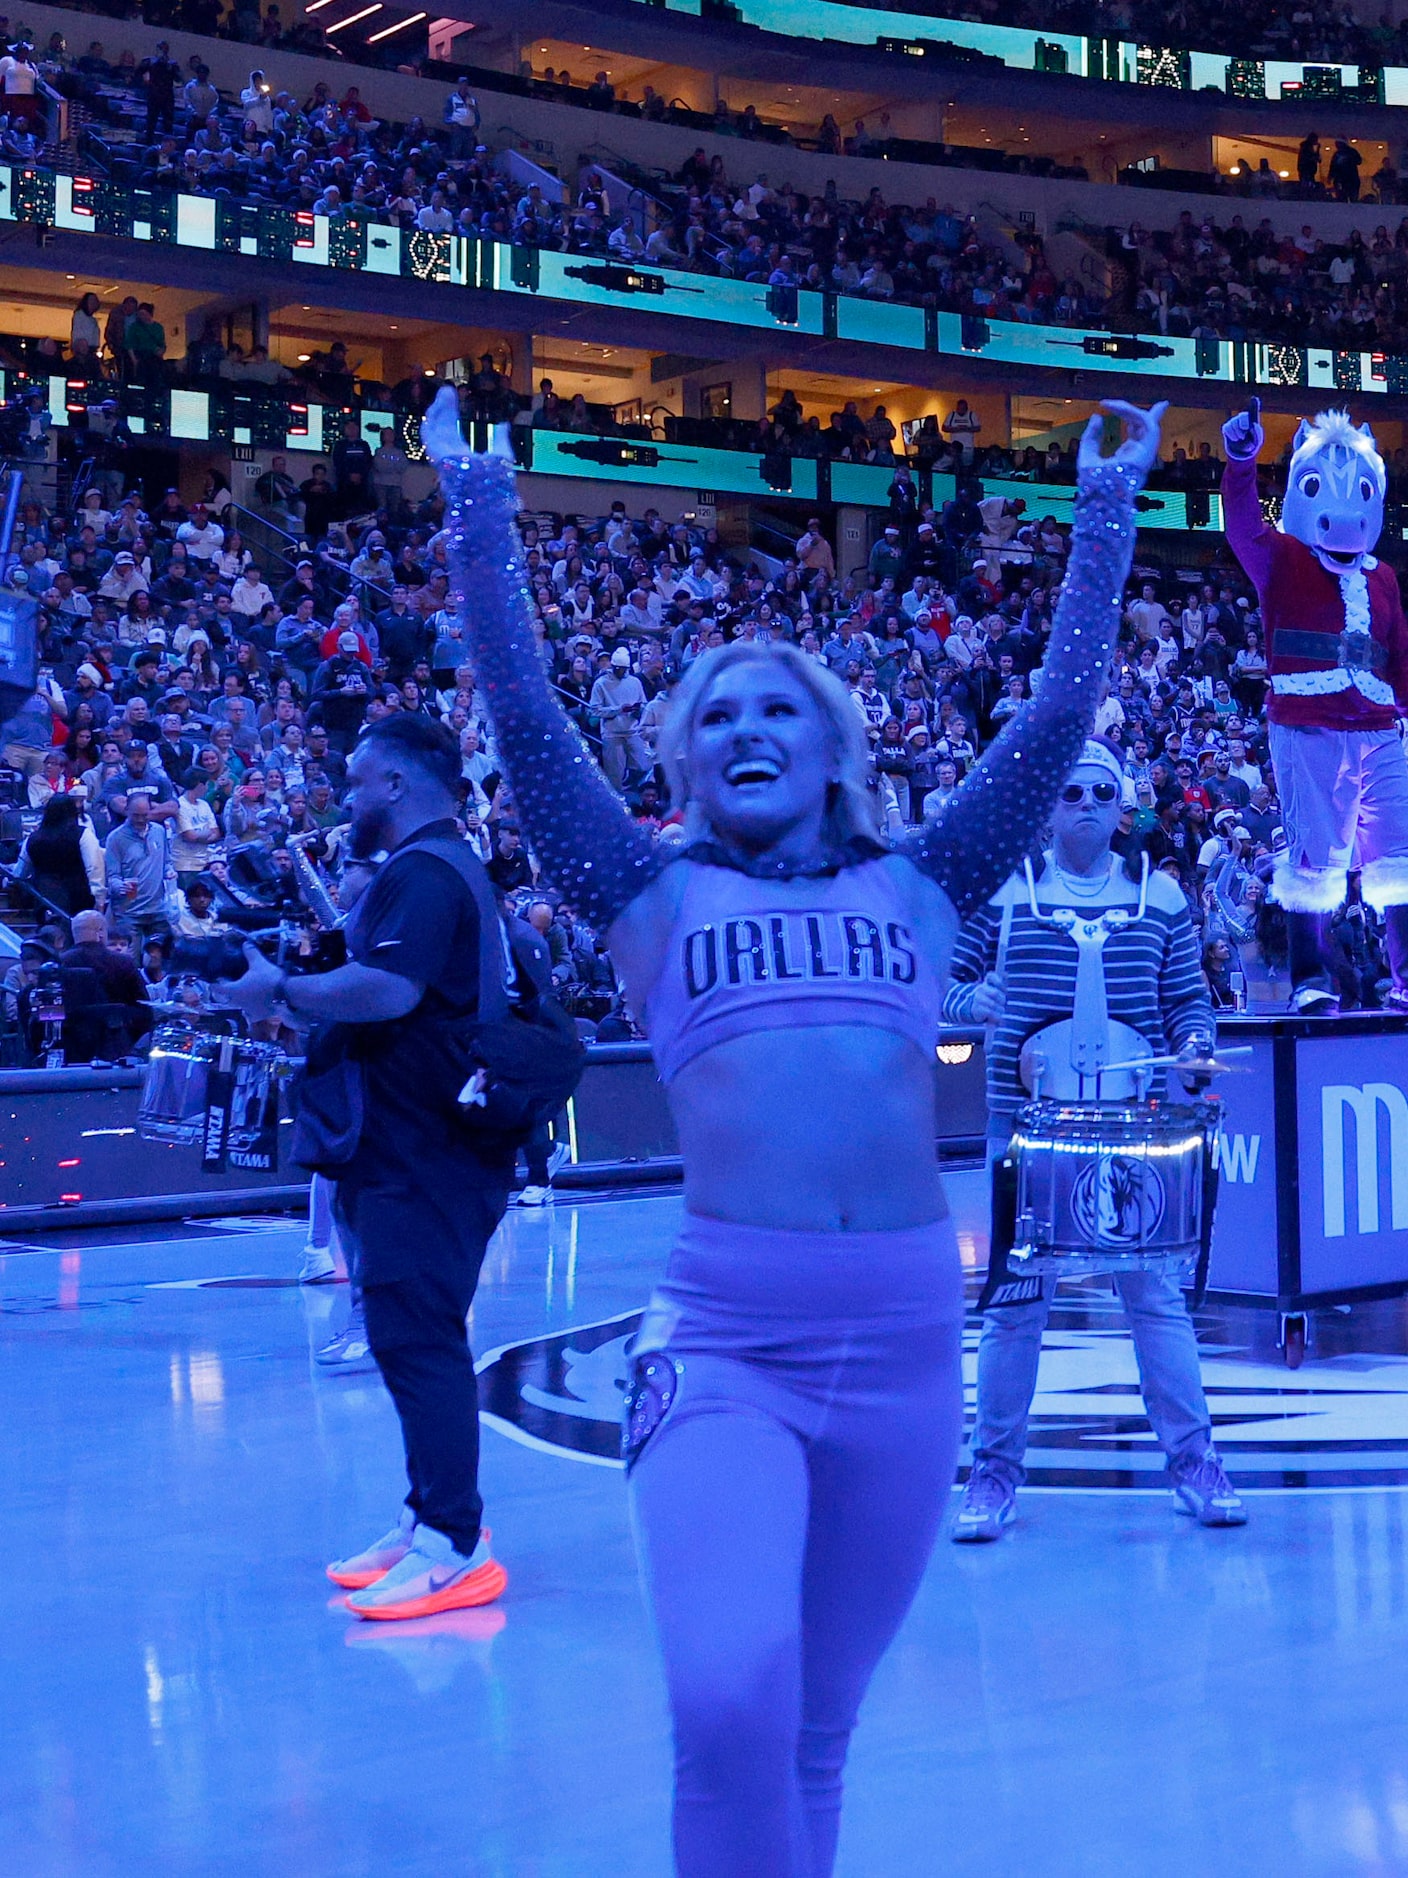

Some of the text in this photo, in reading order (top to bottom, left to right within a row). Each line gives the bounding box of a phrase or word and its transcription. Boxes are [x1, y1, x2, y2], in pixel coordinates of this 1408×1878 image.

[682, 912, 917, 1000] DALLAS
[205, 1116, 224, 1161] TAMA
[237, 1153, 271, 1168] TAMA
[998, 1276, 1040, 1304] TAMA
